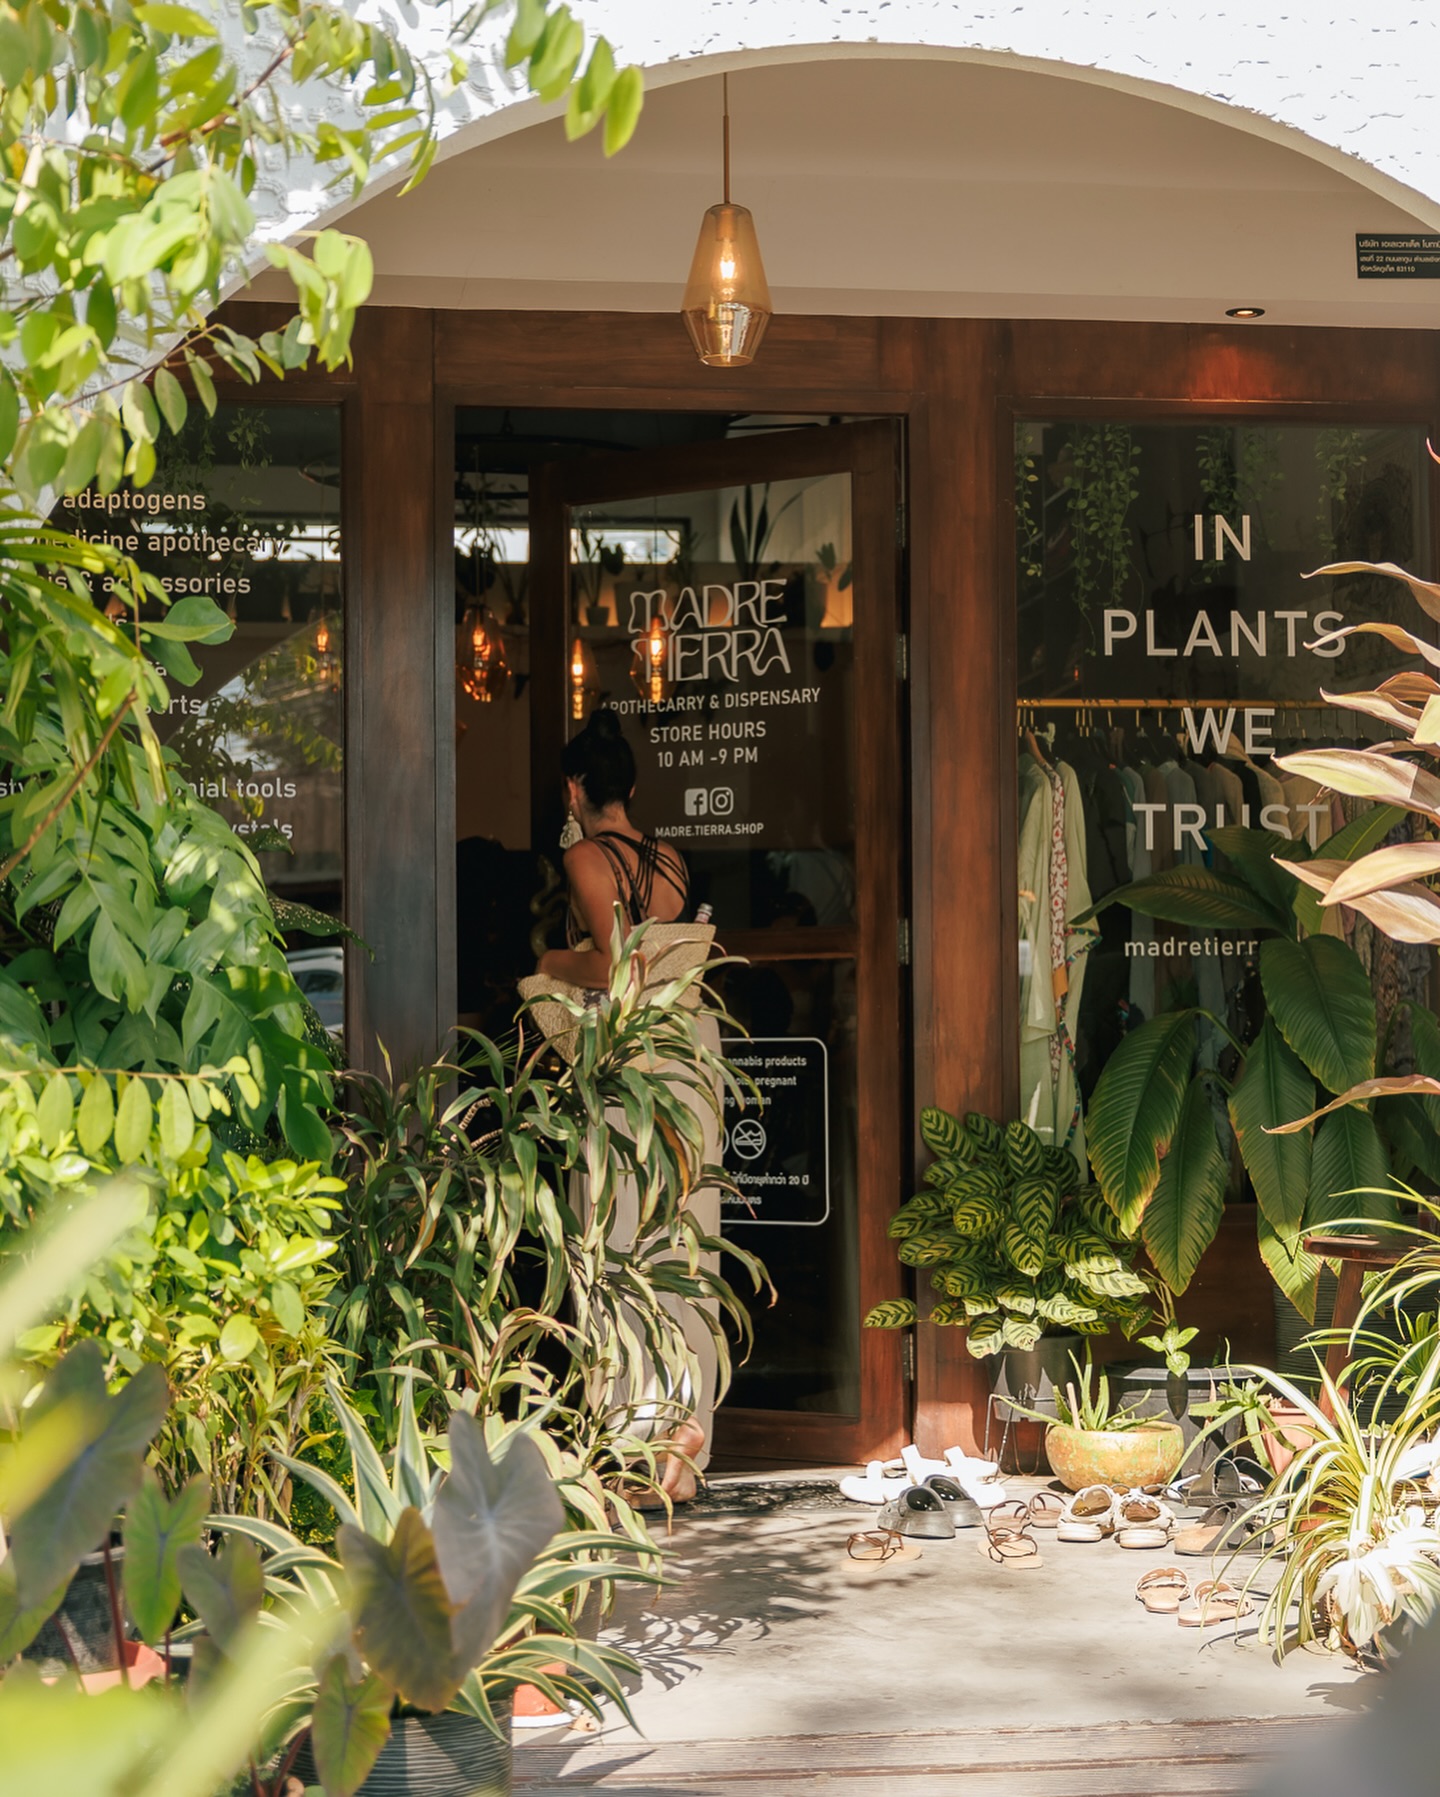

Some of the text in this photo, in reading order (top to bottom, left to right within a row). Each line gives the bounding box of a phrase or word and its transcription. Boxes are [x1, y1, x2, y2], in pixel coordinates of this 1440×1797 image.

[62, 488, 206, 514] adaptogens
[148, 532, 285, 558] apothecary
[1194, 514, 1251, 561] IN
[102, 573, 251, 594] acssories
[628, 578, 788, 633] MADRE
[1103, 609, 1347, 658] PLANTS
[630, 627, 792, 684] TIERRA
[709, 694, 719, 709] &
[725, 687, 821, 708] DISPENSARY
[650, 721, 766, 743] STORE HOURS
[1183, 707, 1276, 755] WE
[657, 751, 674, 768] 10
[679, 749, 704, 767] AM
[733, 747, 758, 764] PM
[236, 777, 297, 798] tools
[655, 823, 764, 837] MADRE.TIERRA.SHOP
[1133, 803, 1329, 851] TRUST
[1124, 936, 1260, 957] madretierr
[765, 1056, 807, 1069] products
[755, 1076, 797, 1088] pregnant
[788, 1175, 800, 1185] 20
